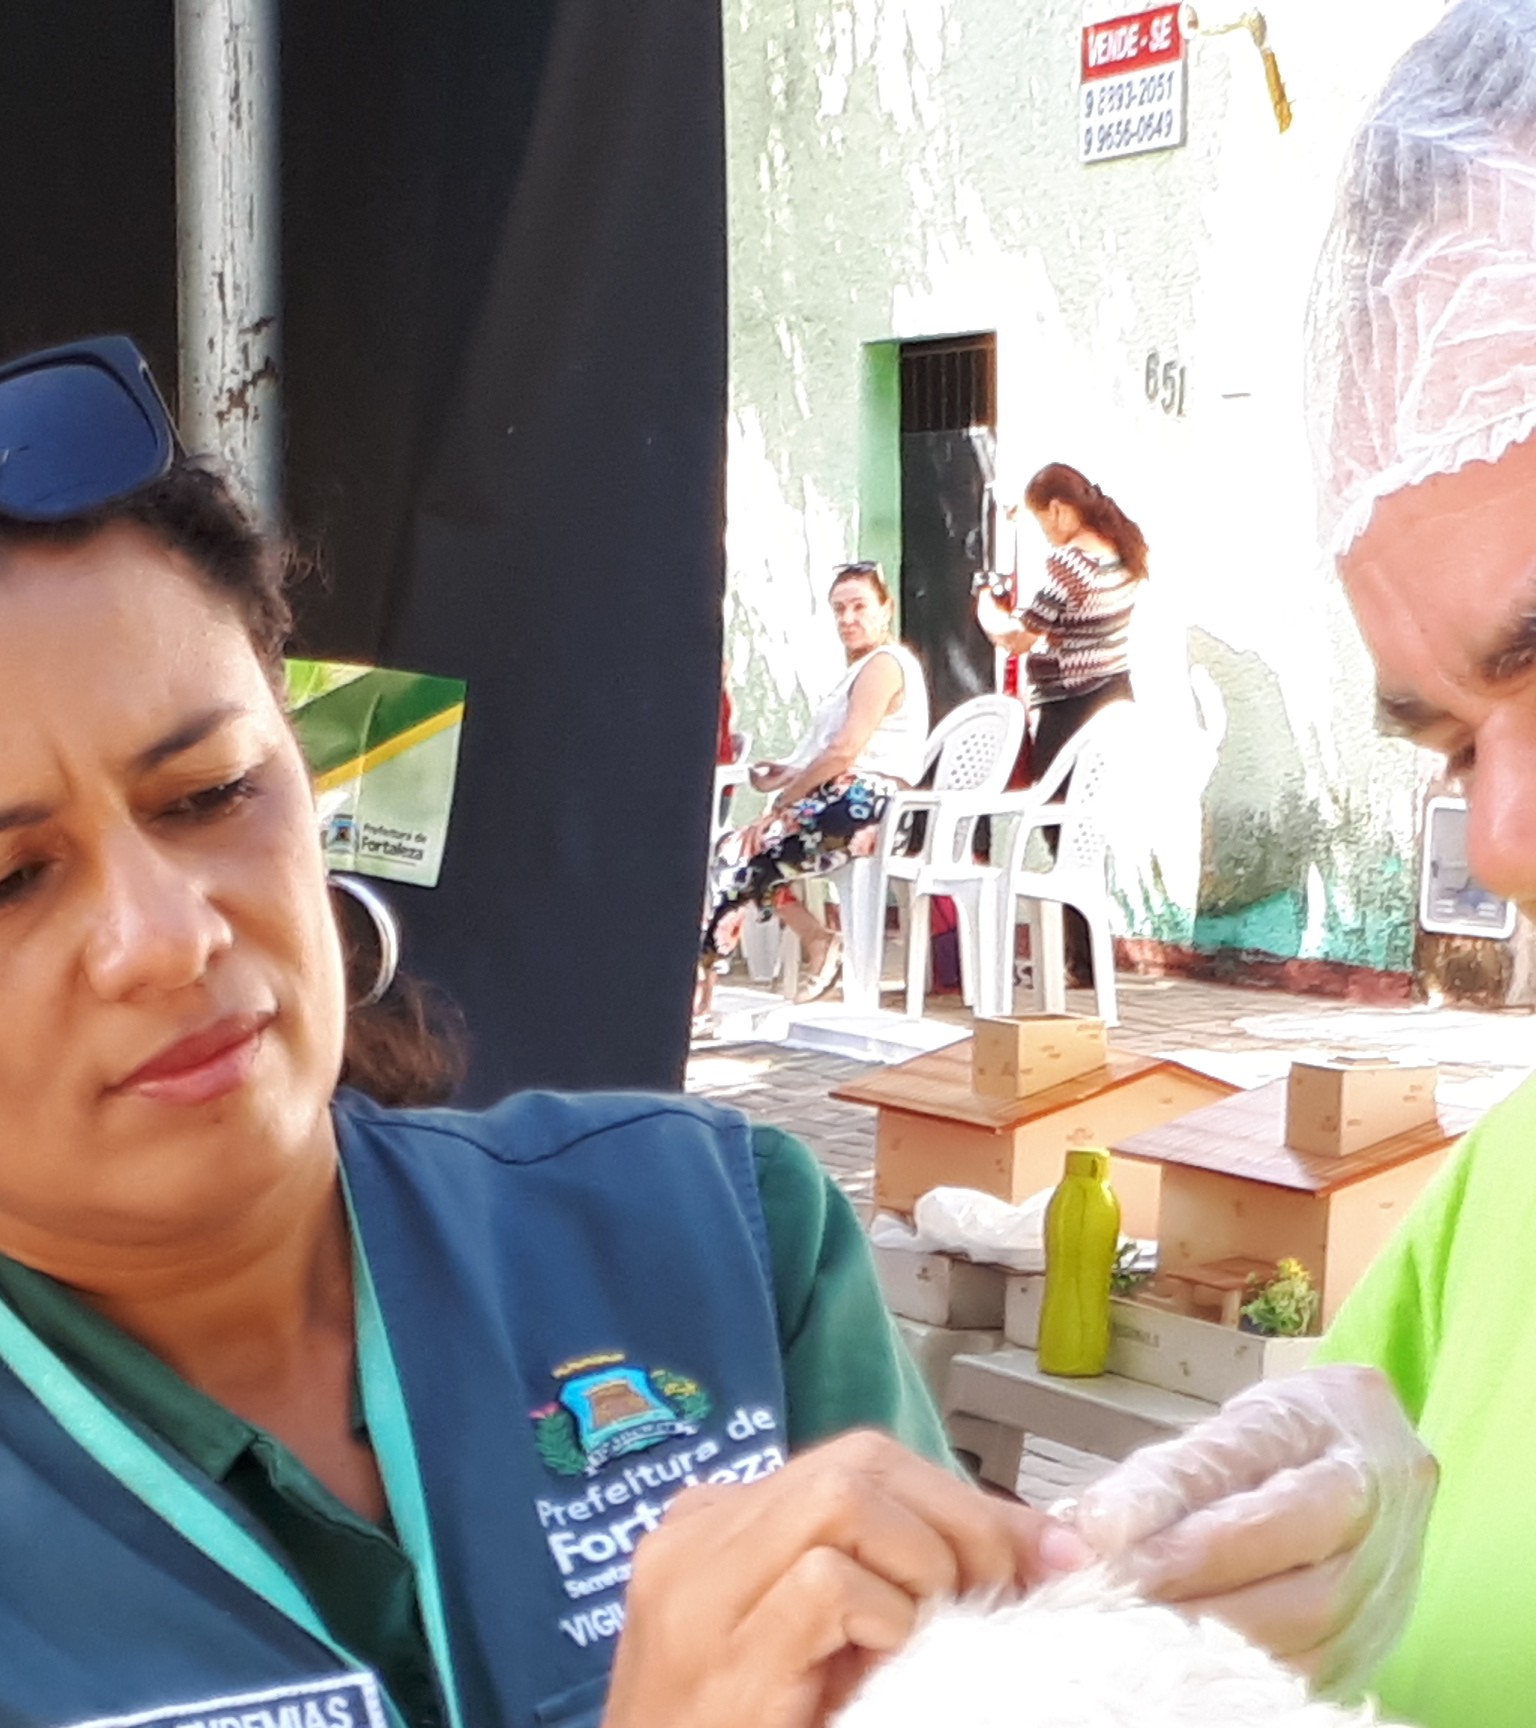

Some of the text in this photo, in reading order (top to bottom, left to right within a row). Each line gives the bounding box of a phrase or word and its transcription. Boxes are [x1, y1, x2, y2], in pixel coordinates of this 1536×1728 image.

[360, 836, 424, 861] Fortaleza
[535, 1438, 720, 1529] Prefeitura
[725, 1405, 777, 1442] de
[548, 1445, 785, 1575] Forteza
